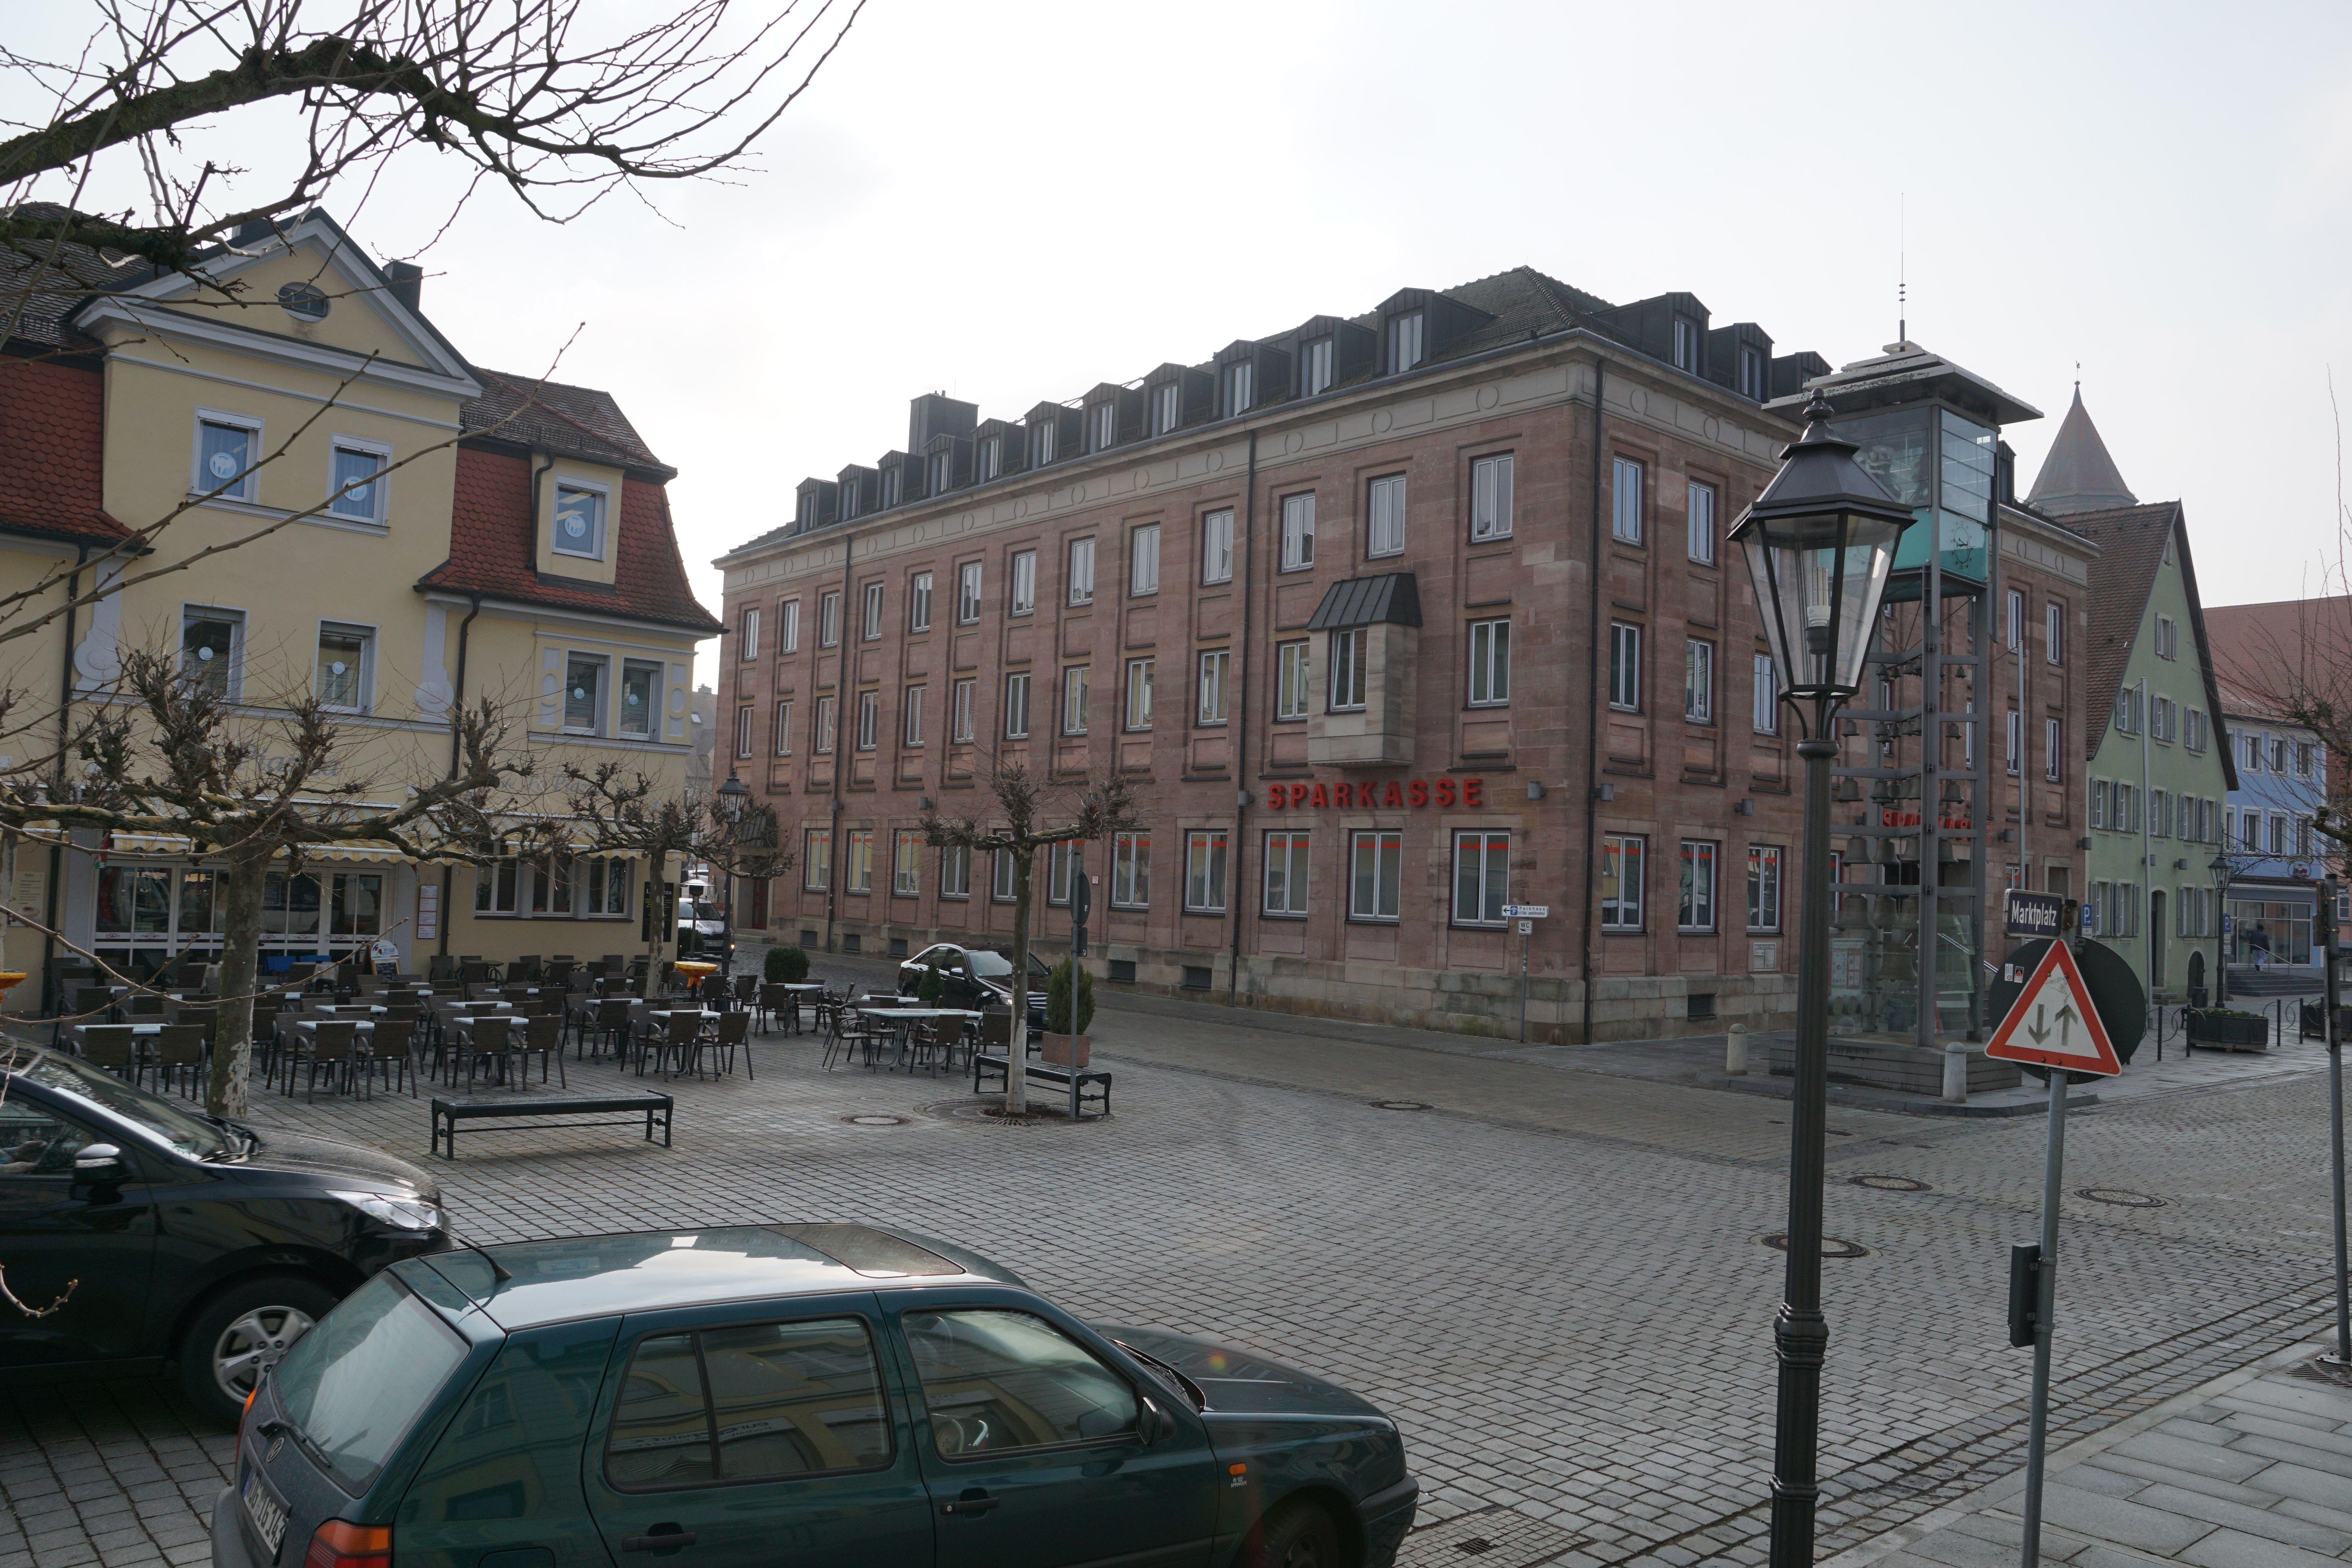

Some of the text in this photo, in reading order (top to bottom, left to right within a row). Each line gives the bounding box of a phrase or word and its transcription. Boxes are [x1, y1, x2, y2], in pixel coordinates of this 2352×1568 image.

[1267, 778, 1483, 809] SPARKASSE
[2011, 900, 2057, 931] Marktplatz
[2084, 907, 2090, 924] P
[265, 1508, 287, 1549] 143
